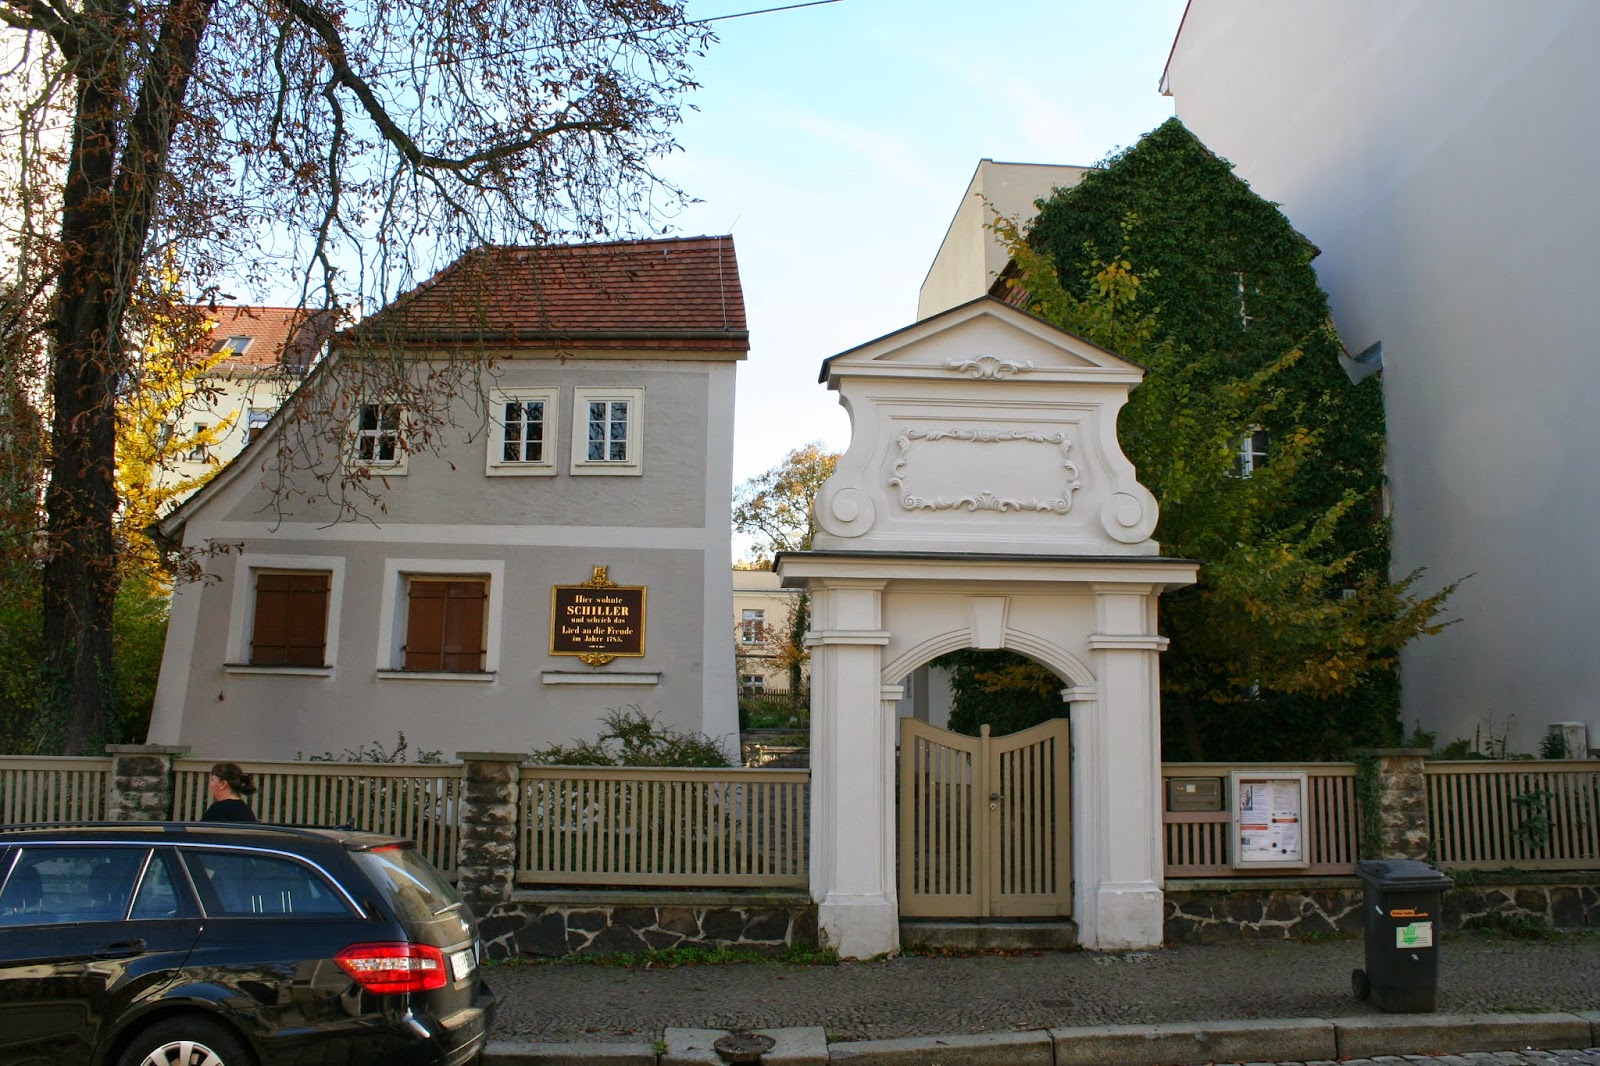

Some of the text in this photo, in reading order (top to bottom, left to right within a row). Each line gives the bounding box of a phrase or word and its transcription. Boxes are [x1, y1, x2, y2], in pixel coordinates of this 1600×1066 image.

[575, 594, 623, 604] Hier wohnte
[566, 605, 629, 616] SCHILLER
[586, 616, 612, 624] schrieb
[562, 625, 580, 634] Lied
[593, 626, 605, 635] die
[607, 626, 634, 635] Freude
